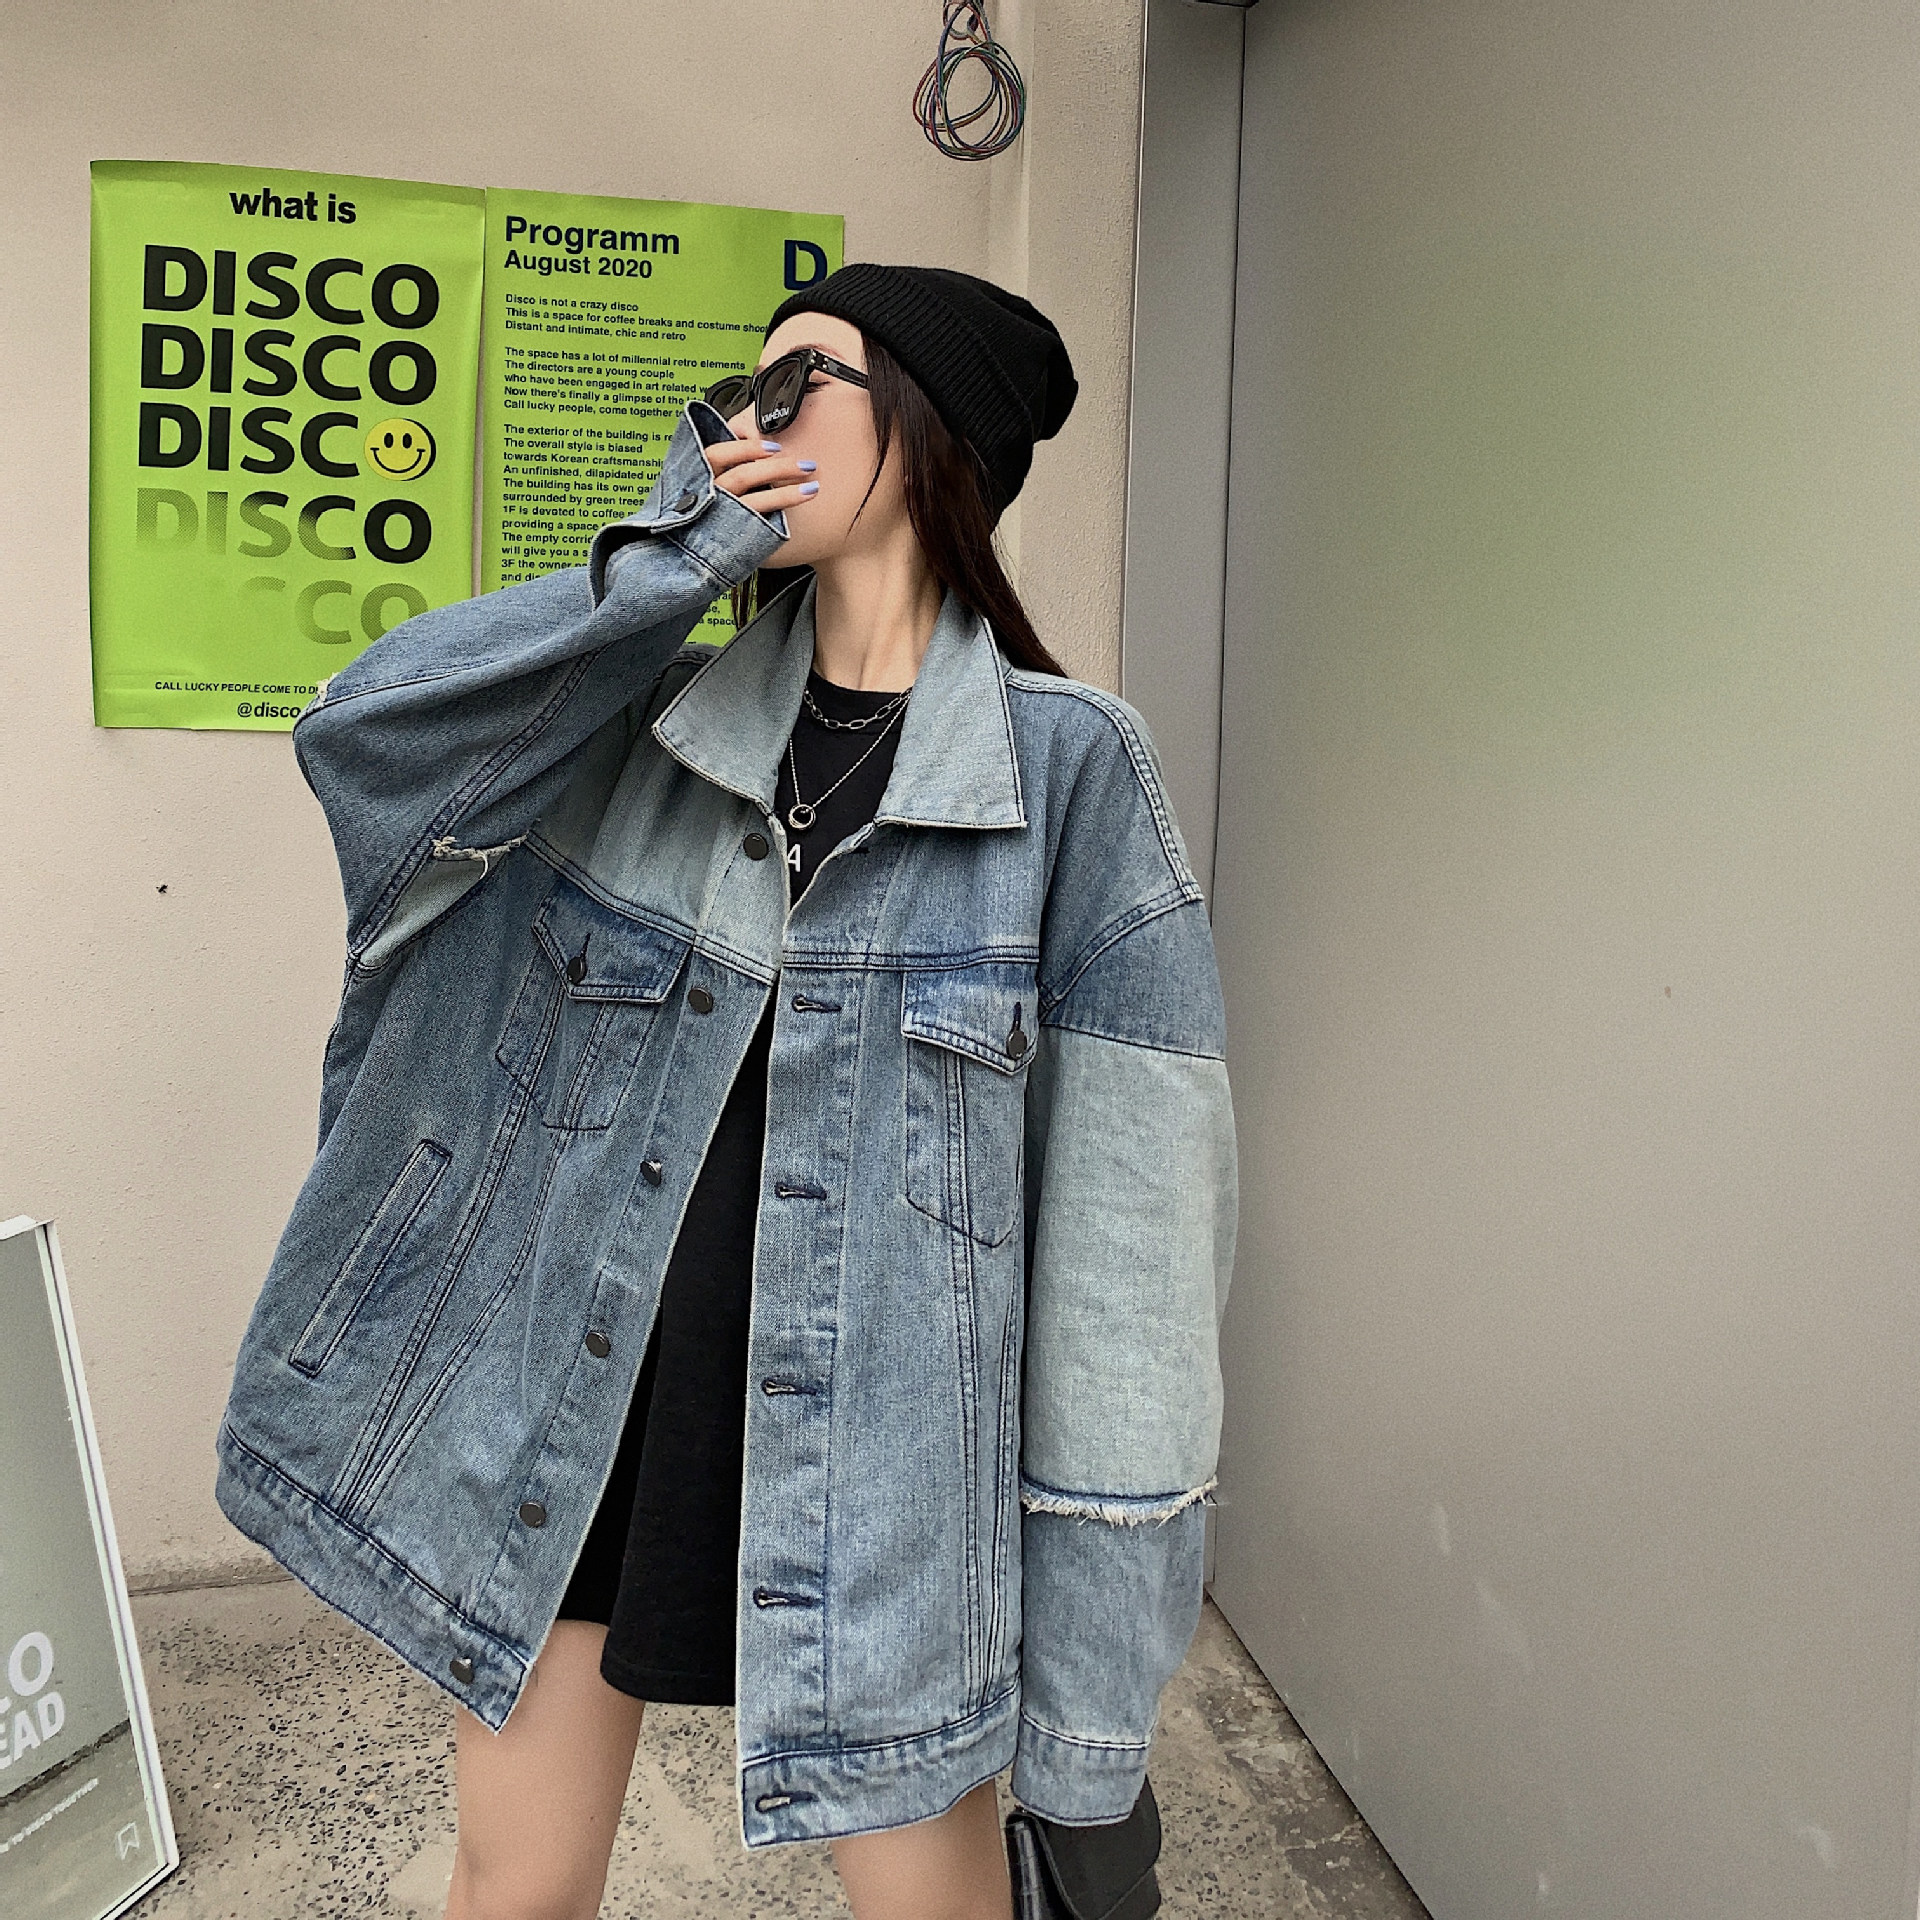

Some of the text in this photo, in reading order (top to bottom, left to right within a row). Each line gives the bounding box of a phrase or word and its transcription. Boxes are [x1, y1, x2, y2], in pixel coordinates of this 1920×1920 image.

[229, 187, 357, 223] what is
[506, 216, 679, 254] Programm
[504, 250, 652, 278] August 2020
[143, 244, 439, 330] DISCO
[506, 294, 537, 305] Disco
[540, 296, 549, 306] is
[552, 299, 568, 307] not
[580, 301, 608, 312] crazy
[611, 302, 639, 312] disco
[506, 307, 528, 318] This
[532, 309, 541, 319] is
[553, 313, 584, 322] space
[587, 313, 602, 323] for
[604, 315, 636, 325] coffee
[639, 316, 673, 328] breaks
[676, 320, 695, 329] and
[697, 322, 741, 331] costume
[506, 320, 687, 342] Distant and intimate, chic and retro
[140, 322, 437, 406] DISCO
[505, 347, 525, 357] The
[528, 350, 560, 360] space
[562, 351, 581, 361] has
[593, 353, 606, 362] lot
[609, 354, 619, 363] of
[622, 355, 671, 366] millennial
[674, 358, 698, 368] retro
[700, 360, 746, 371] elements
[504, 360, 525, 370] The
[527, 361, 575, 373] directors
[577, 367, 594, 375] are
[606, 368, 638, 379] young
[640, 370, 675, 381] couple
[504, 374, 527, 383] who
[530, 375, 555, 385] have
[558, 377, 583, 387] been
[586, 380, 631, 391] engaged
[633, 381, 643, 390] in
[646, 382, 660, 391] art
[662, 383, 697, 394] related
[504, 386, 528, 396] Now
[531, 388, 567, 399] there's
[569, 390, 601, 403] finally
[613, 393, 653, 405] glimpse
[656, 396, 666, 404] of
[668, 396, 685, 406] the
[504, 400, 525, 409] Call
[528, 401, 556, 413] lucky
[559, 405, 596, 415] people,
[599, 407, 628, 415] come
[630, 408, 673, 419] together
[504, 424, 525, 435] The
[528, 426, 570, 437] exterior
[573, 428, 584, 437] of
[586, 429, 603, 439] the
[606, 430, 649, 443] building
[652, 432, 661, 442] is
[504, 438, 643, 454] The overall style is biased
[504, 452, 548, 462] towards
[551, 454, 589, 464] Korean
[504, 465, 519, 474] An
[522, 466, 582, 479] unfinished,
[586, 468, 644, 481] dilapidated
[503, 478, 524, 488] The
[527, 480, 571, 493] building
[574, 481, 593, 491] has
[597, 482, 610, 492] its
[613, 485, 635, 493] own
[503, 494, 645, 507] surrounded by green trees
[520, 506, 529, 515] is
[532, 506, 575, 517] devoted
[579, 508, 590, 518] to
[592, 509, 625, 519] coffee
[135, 487, 432, 564] DISCO
[502, 520, 554, 532] providing
[557, 522, 564, 530] a
[567, 523, 599, 533] space
[502, 532, 523, 542] The
[526, 534, 560, 546] empty
[502, 546, 521, 555] will
[524, 546, 547, 558] give
[550, 549, 570, 559] you
[502, 559, 515, 568] 3F
[518, 560, 536, 569] the
[538, 562, 573, 570] owner
[501, 573, 522, 582] and
[155, 681, 182, 691] CALL
[185, 683, 220, 692] LUCKY
[221, 684, 260, 693] PEOPLE
[262, 685, 291, 694] COME
[293, 685, 307, 694] TO
